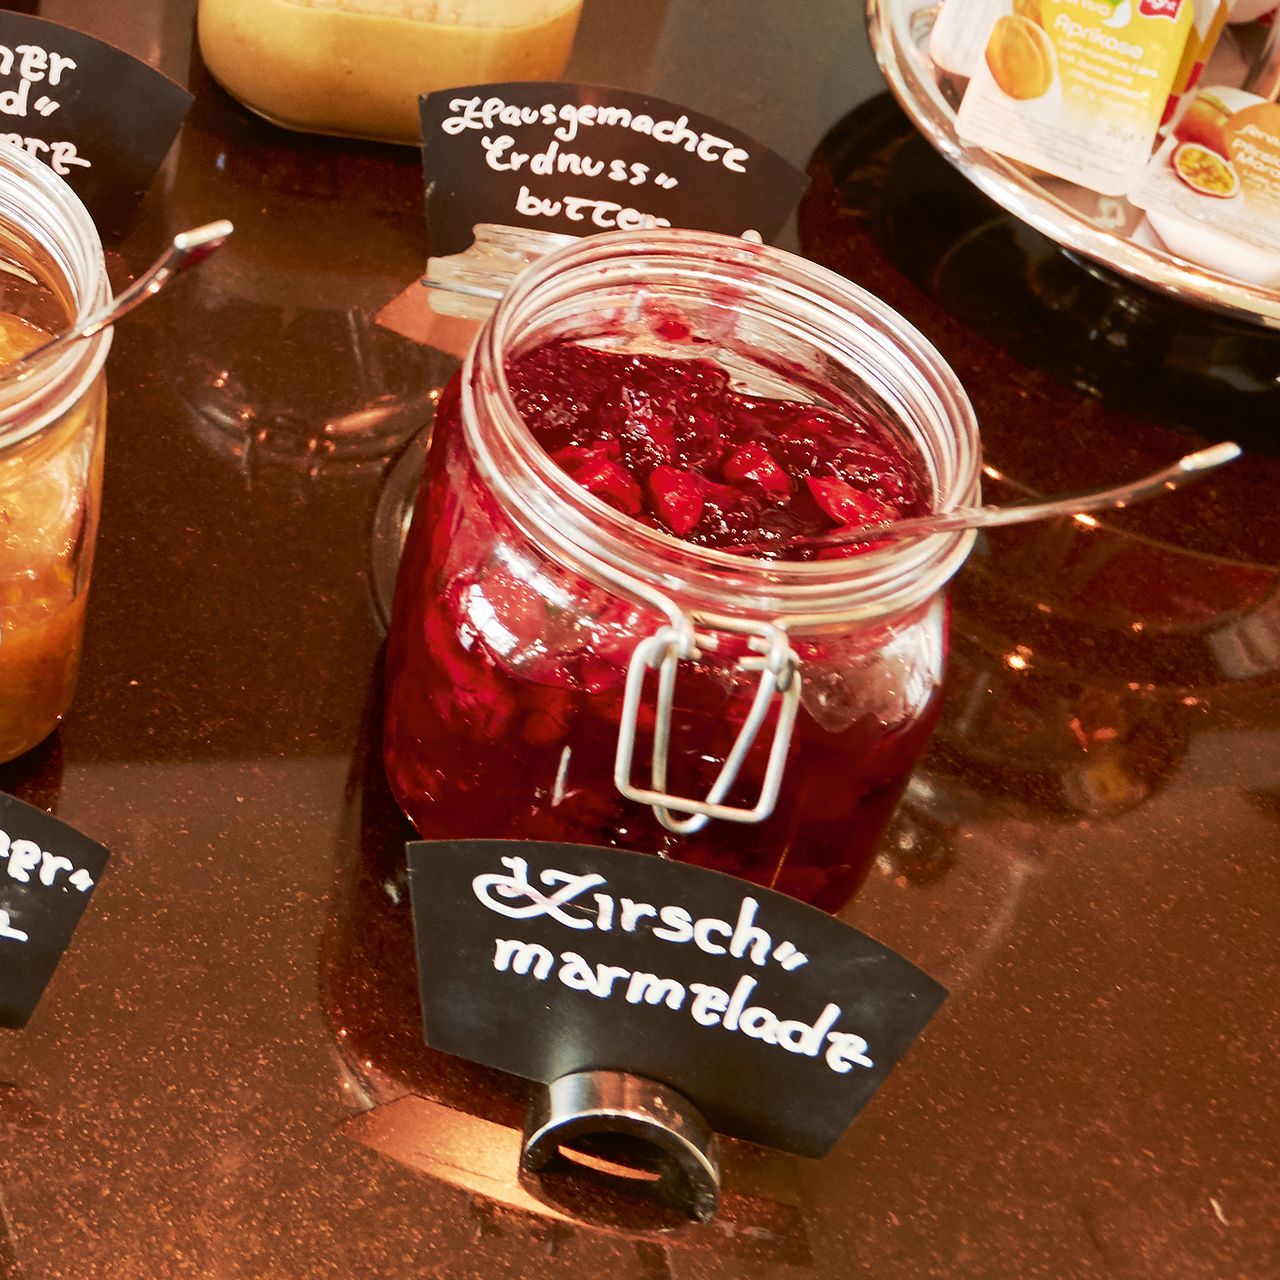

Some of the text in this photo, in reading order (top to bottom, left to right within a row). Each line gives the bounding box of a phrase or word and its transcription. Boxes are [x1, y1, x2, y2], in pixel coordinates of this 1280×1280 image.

[1053, 12, 1145, 61] Aprikose
[441, 95, 752, 174] Hausgemachte
[493, 937, 874, 1075] marmelade
